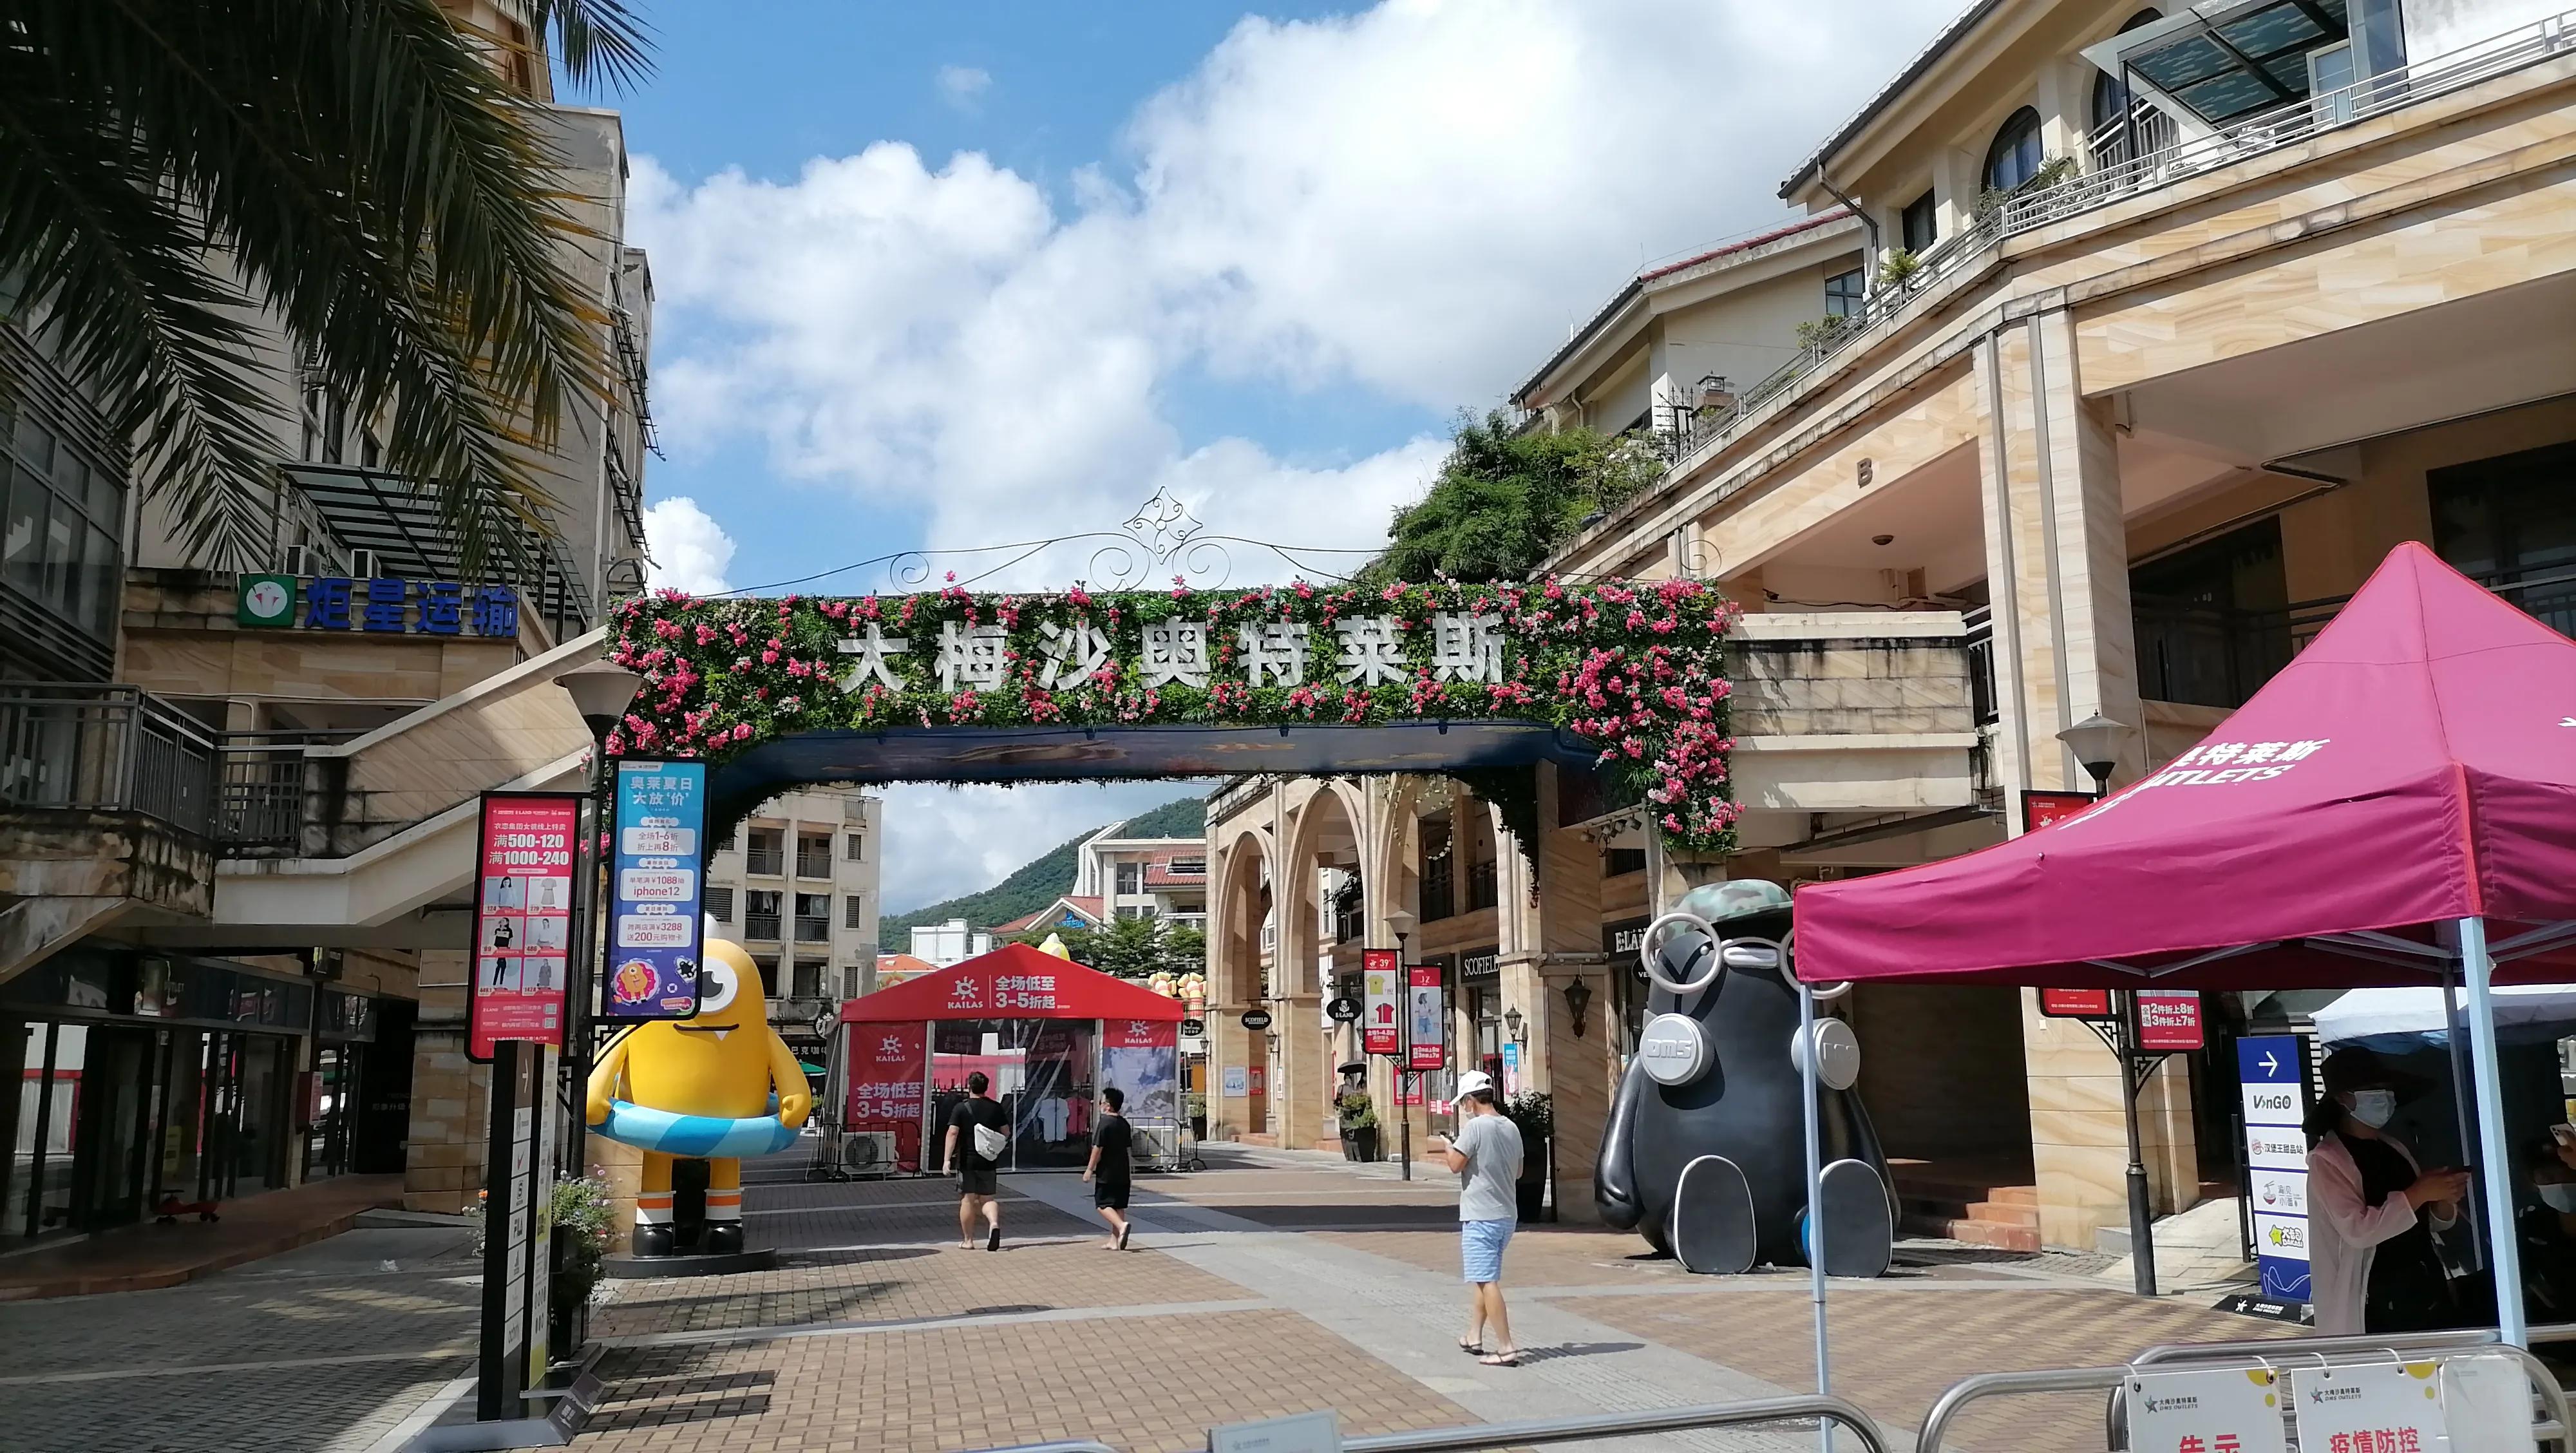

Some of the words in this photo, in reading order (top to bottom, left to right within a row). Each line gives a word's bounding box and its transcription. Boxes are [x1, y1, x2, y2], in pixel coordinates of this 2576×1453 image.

[1857, 458, 1872, 489] B
[305, 576, 518, 637] 炬星运输
[837, 611, 1506, 693] 大梅沙奥特莱斯
[630, 776, 692, 791] 奥莱夏日
[493, 833, 565, 848] 满500-120
[489, 850, 569, 866] 满1000-240
[633, 886, 680, 898] iphone12
[1464, 954, 1500, 976] SCOFIELD
[995, 975, 1056, 991] 全场低至
[947, 1001, 983, 1009] KAILAS
[995, 992, 1056, 1009] 3-5折起
[2151, 1003, 2195, 1015] 2件折上8折
[2152, 1016, 2195, 1027] 3件折上7折
[875, 1054, 906, 1063] KAILAS
[856, 1082, 922, 1099] 全场低至
[857, 1101, 920, 1119] 3-5折起
[2264, 1143, 2304, 1155] 汉堡王甜品站
[2329, 1426, 2421, 1453] 疫情防控
